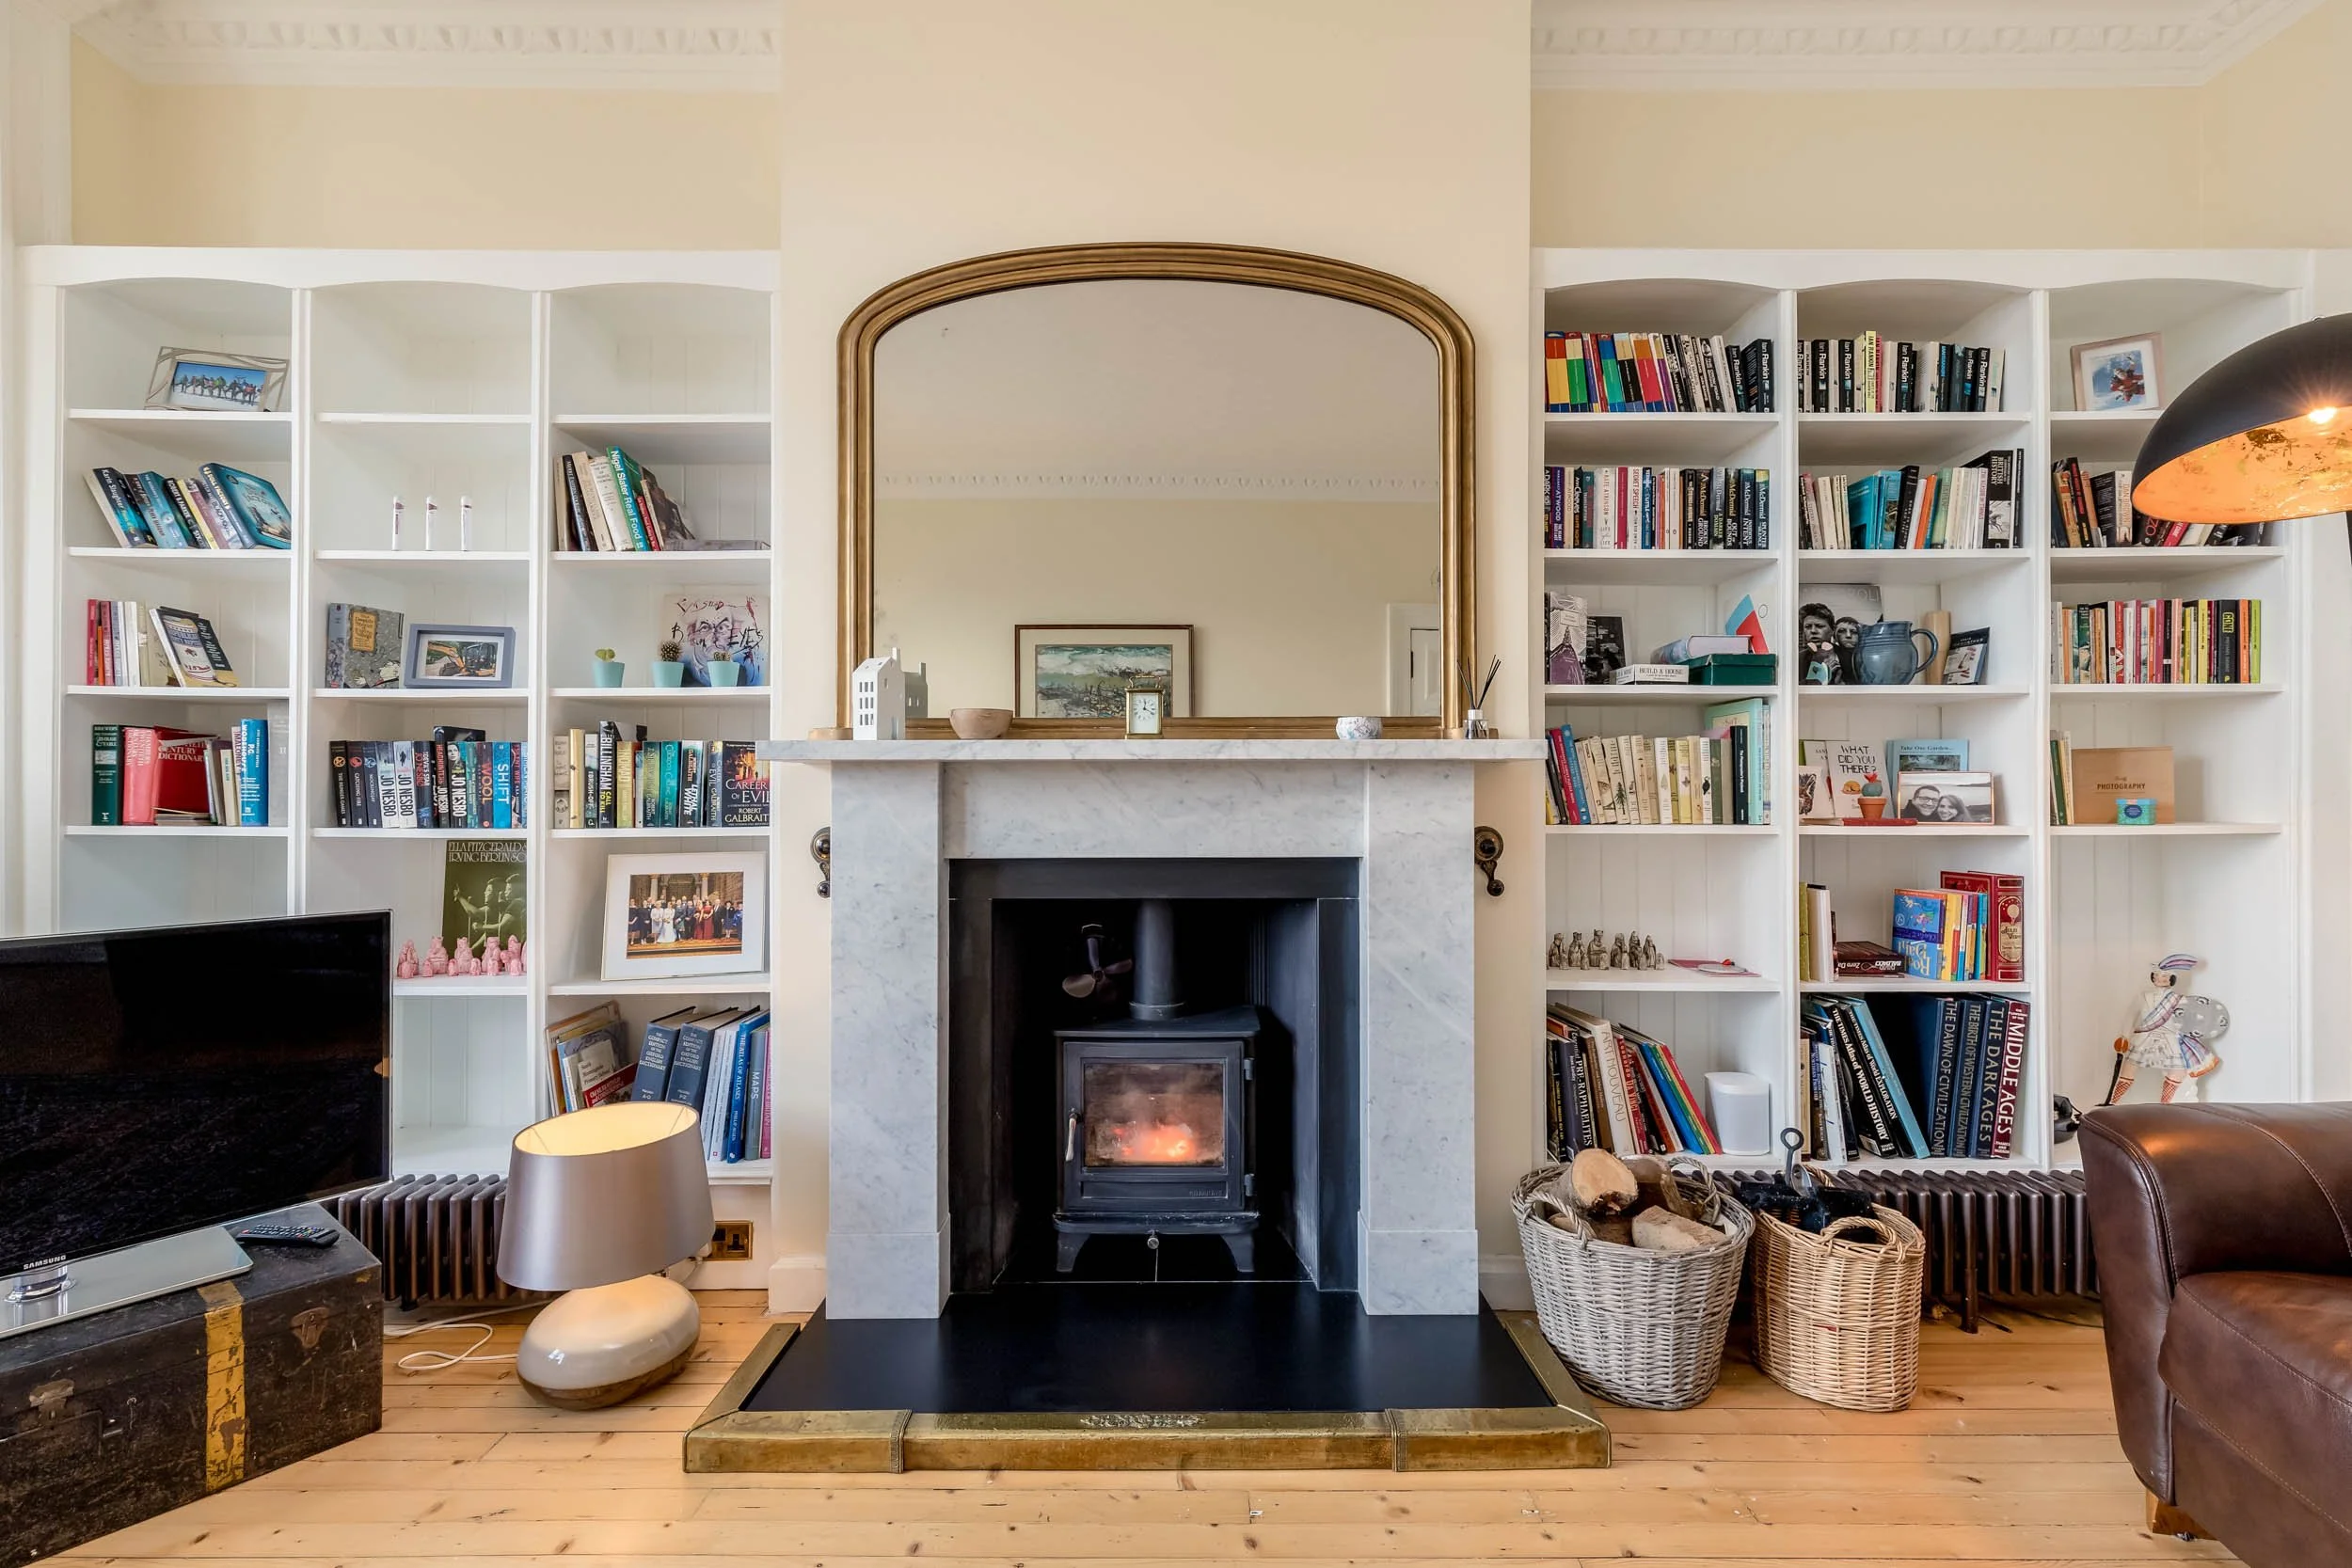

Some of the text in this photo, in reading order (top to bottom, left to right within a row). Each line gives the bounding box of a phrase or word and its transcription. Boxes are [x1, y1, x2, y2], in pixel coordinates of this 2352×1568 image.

[1733, 359, 1742, 385] Rankin
[1979, 361, 1988, 387] Rankin
[102, 469, 123, 509] Karin Slaughter
[215, 484, 229, 506] FACTORY
[611, 451, 641, 540] Nigel Slater Real Food
[158, 746, 197, 754] CENTURY
[158, 752, 204, 762] DICTIONAR
[416, 752, 422, 762] JO
[437, 744, 445, 784] HEADHUNTERS
[600, 737, 612, 790] BILLINGHAM
[1837, 755, 1876, 764] DID YOU
[1840, 745, 1869, 754] WHAT
[618, 752, 631, 783] NOMAD
[1839, 764, 1877, 773] THERE?
[380, 775, 397, 816] JO NESBO
[398, 774, 414, 816] JO NESBO
[452, 774, 468, 817] JO NESBO
[481, 762, 492, 805] WOOL
[497, 764, 509, 804] SHIFT
[725, 779, 767, 790] CAREER
[438, 794, 449, 814] NESBO
[684, 787, 692, 816] WHITE
[725, 814, 770, 823] GALBRAIT
[448, 842, 520, 852] ELLA FITZGERALD
[449, 852, 479, 863] IRVING
[480, 851, 509, 863] BERLIN
[640, 1060, 666, 1070] DICTIONARY
[674, 1060, 701, 1070] DICTIONARY
[2002, 1022, 2025, 1086] MIDDLE
[738, 1066, 743, 1074] OF
[1601, 1030, 1626, 1121] ART NOUVEAU
[1619, 1040, 1638, 1112] Leonardo DA VINCI
[1833, 1009, 1889, 1141] THE TIMES Atlas of WORLD HISTORY
[1853, 1022, 1863, 1040] TIMES
[1861, 1039, 1870, 1053] Atlas
[1868, 1059, 1880, 1076] World
[1875, 1075, 1898, 1119] EXPLORATION
[1932, 1002, 1958, 1148] THE DAWN OF CIVILIZATION
[1955, 1004, 1981, 1148] THE BIRTH OF WESTERN CIVILIZATION
[1979, 1006, 2004, 1142] THE DARK AGES
[751, 1071, 760, 1100] MAPS
[1571, 1032, 1593, 1146] Essential PRE-RAPHAELITES
[1996, 1089, 2016, 1134] AGES
[24, 1255, 67, 1270] SAMSUNG
